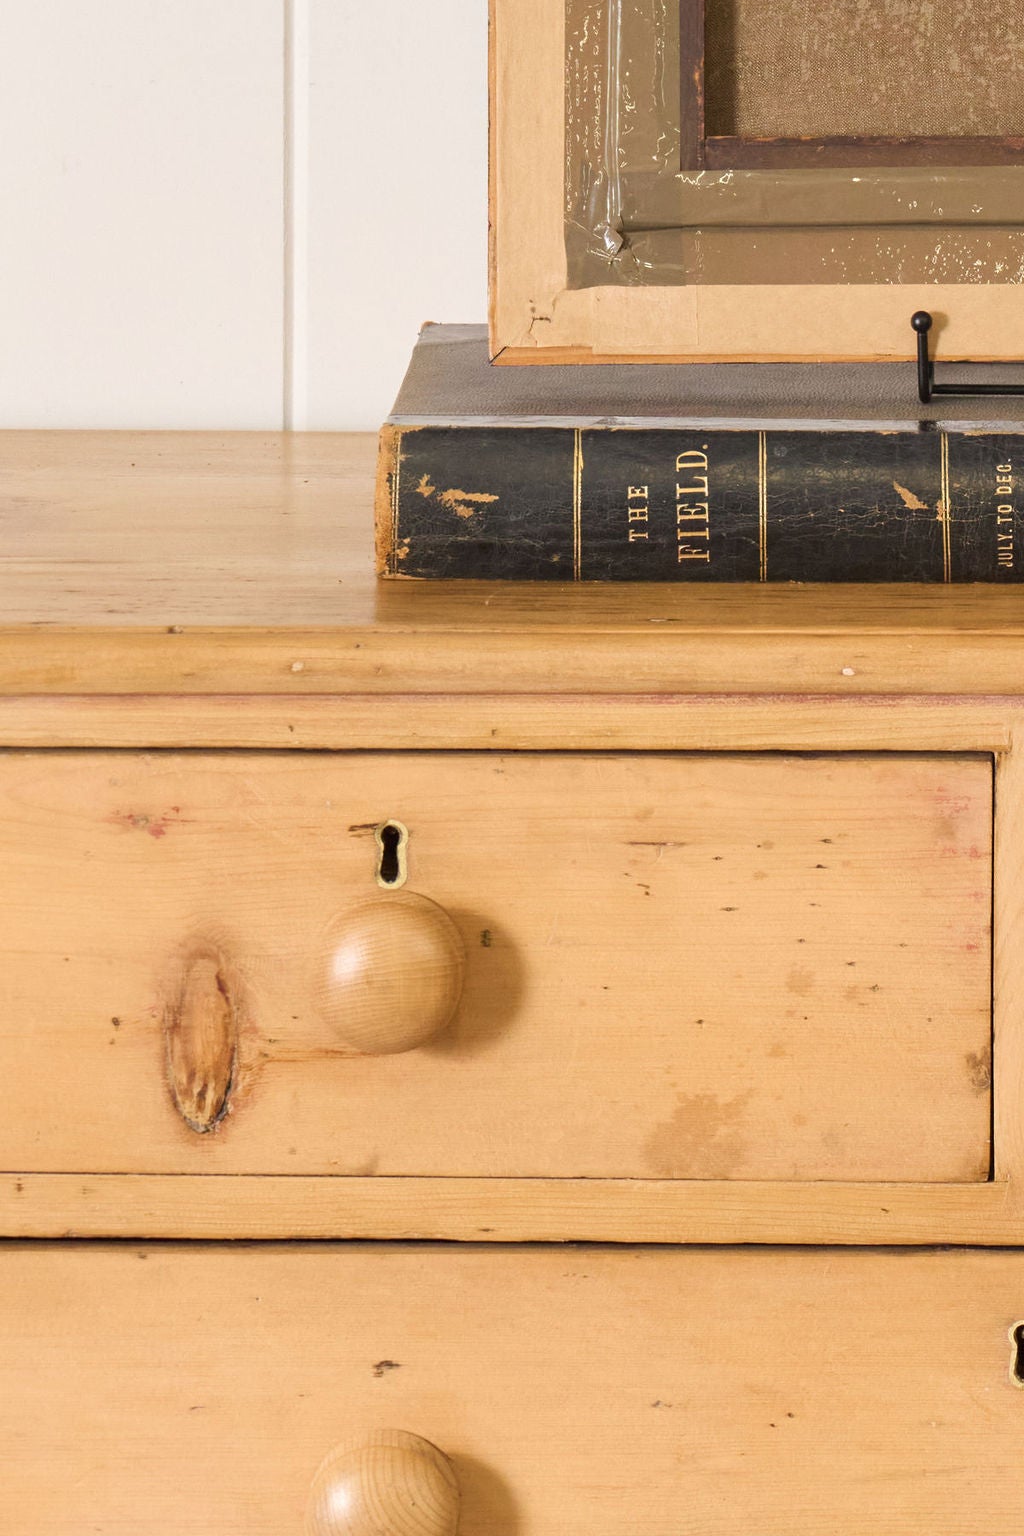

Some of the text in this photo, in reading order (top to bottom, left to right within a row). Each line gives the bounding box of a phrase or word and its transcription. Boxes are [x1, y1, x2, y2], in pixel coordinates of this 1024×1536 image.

[627, 485, 649, 542] THE
[676, 444, 710, 563] FIELD.
[996, 458, 1014, 568] JULY. TO DEC.
